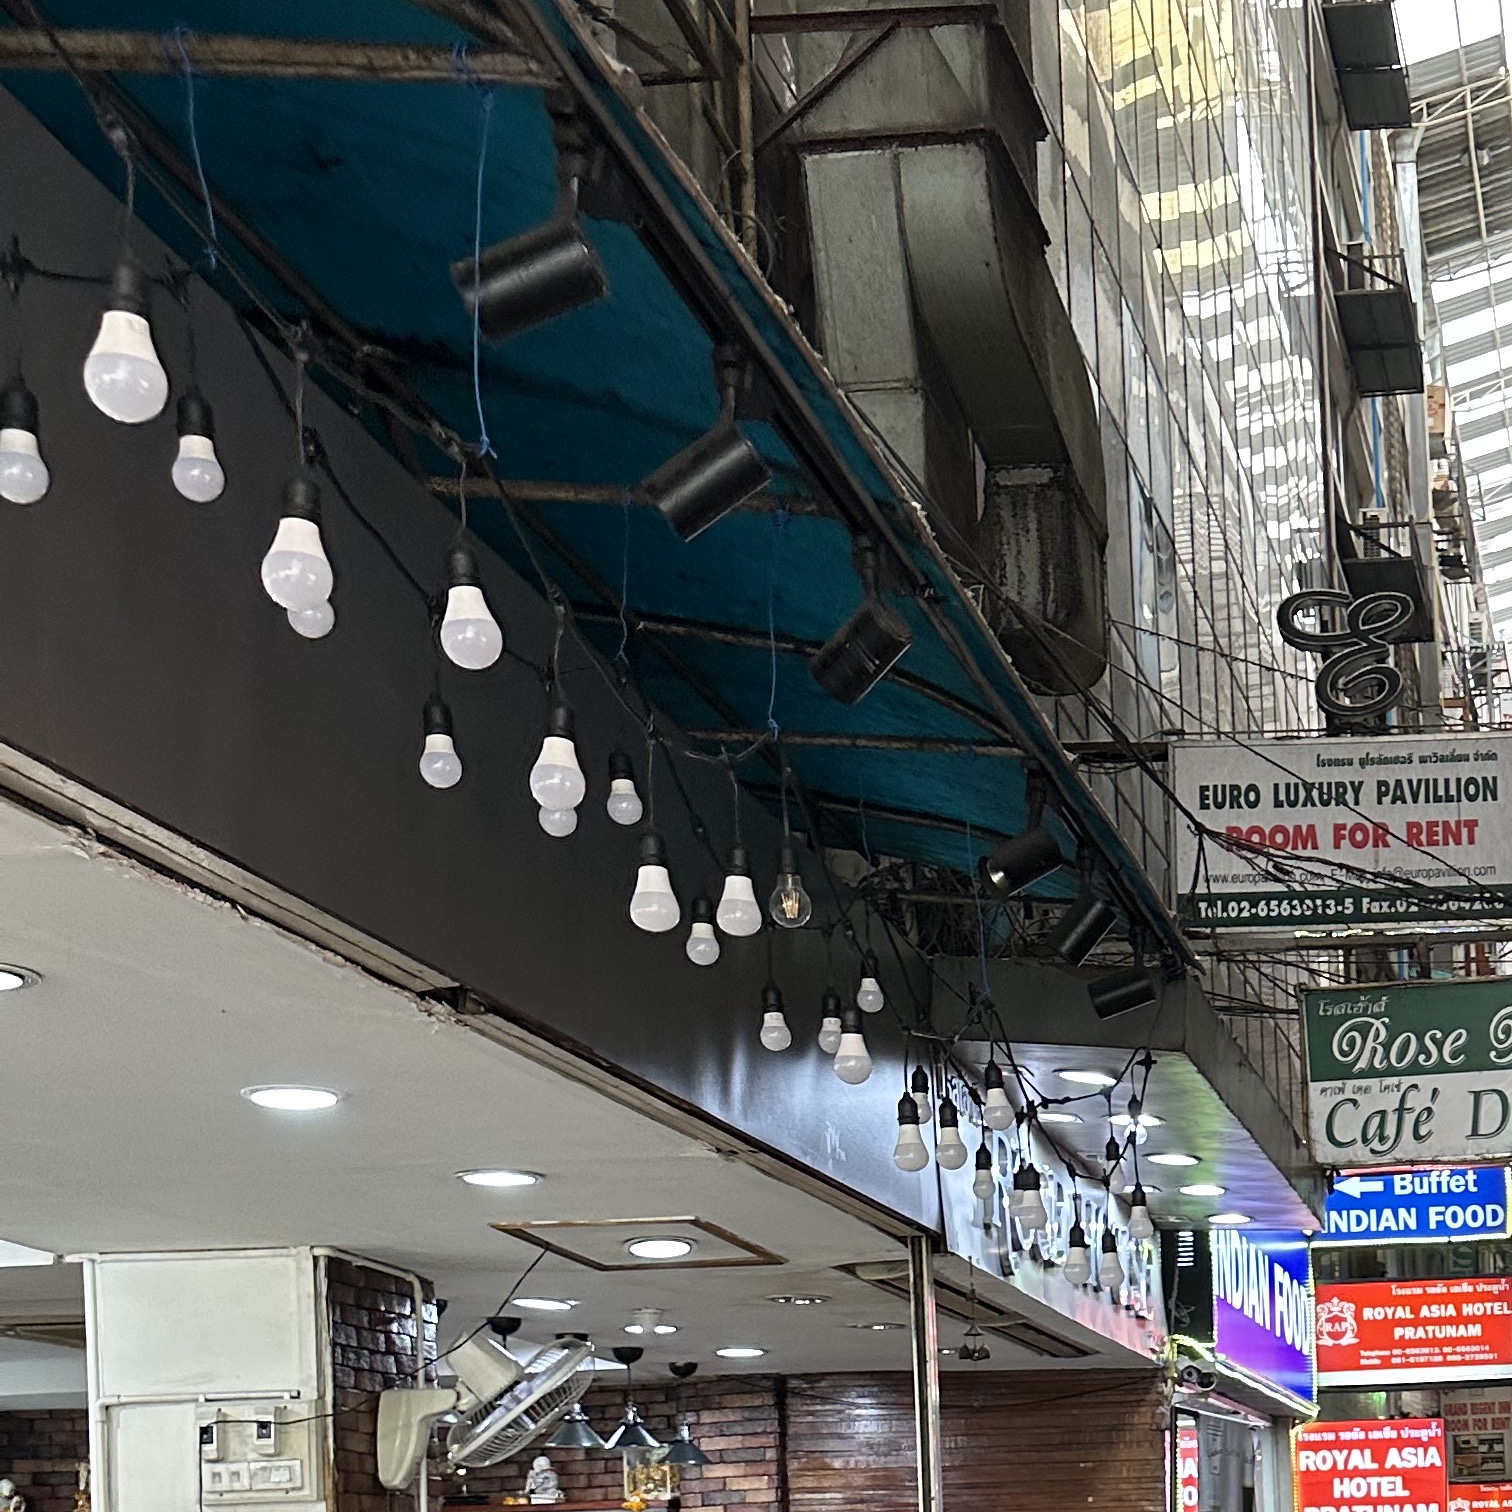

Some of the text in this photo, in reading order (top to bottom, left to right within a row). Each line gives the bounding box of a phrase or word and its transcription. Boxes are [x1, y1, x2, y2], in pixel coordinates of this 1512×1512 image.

[1198, 776, 1499, 810] EURO LUXURY PAVILLION
[1225, 819, 1479, 852] ROOM FOR RENT
[1332, 1016, 1470, 1075] Rose
[1325, 1083, 1440, 1157] Café
[1394, 1168, 1478, 1195] Buffet
[1322, 1203, 1505, 1234] INDIAN FOOD
[1209, 1229, 1311, 1356] INDIAN FOOD
[1362, 1301, 1512, 1321] ROYAL ASIA HOTEL
[1393, 1323, 1483, 1341] PRATUNAM
[1299, 1446, 1443, 1472] ROYAL ASIA
[1333, 1475, 1411, 1499] HOTEL
